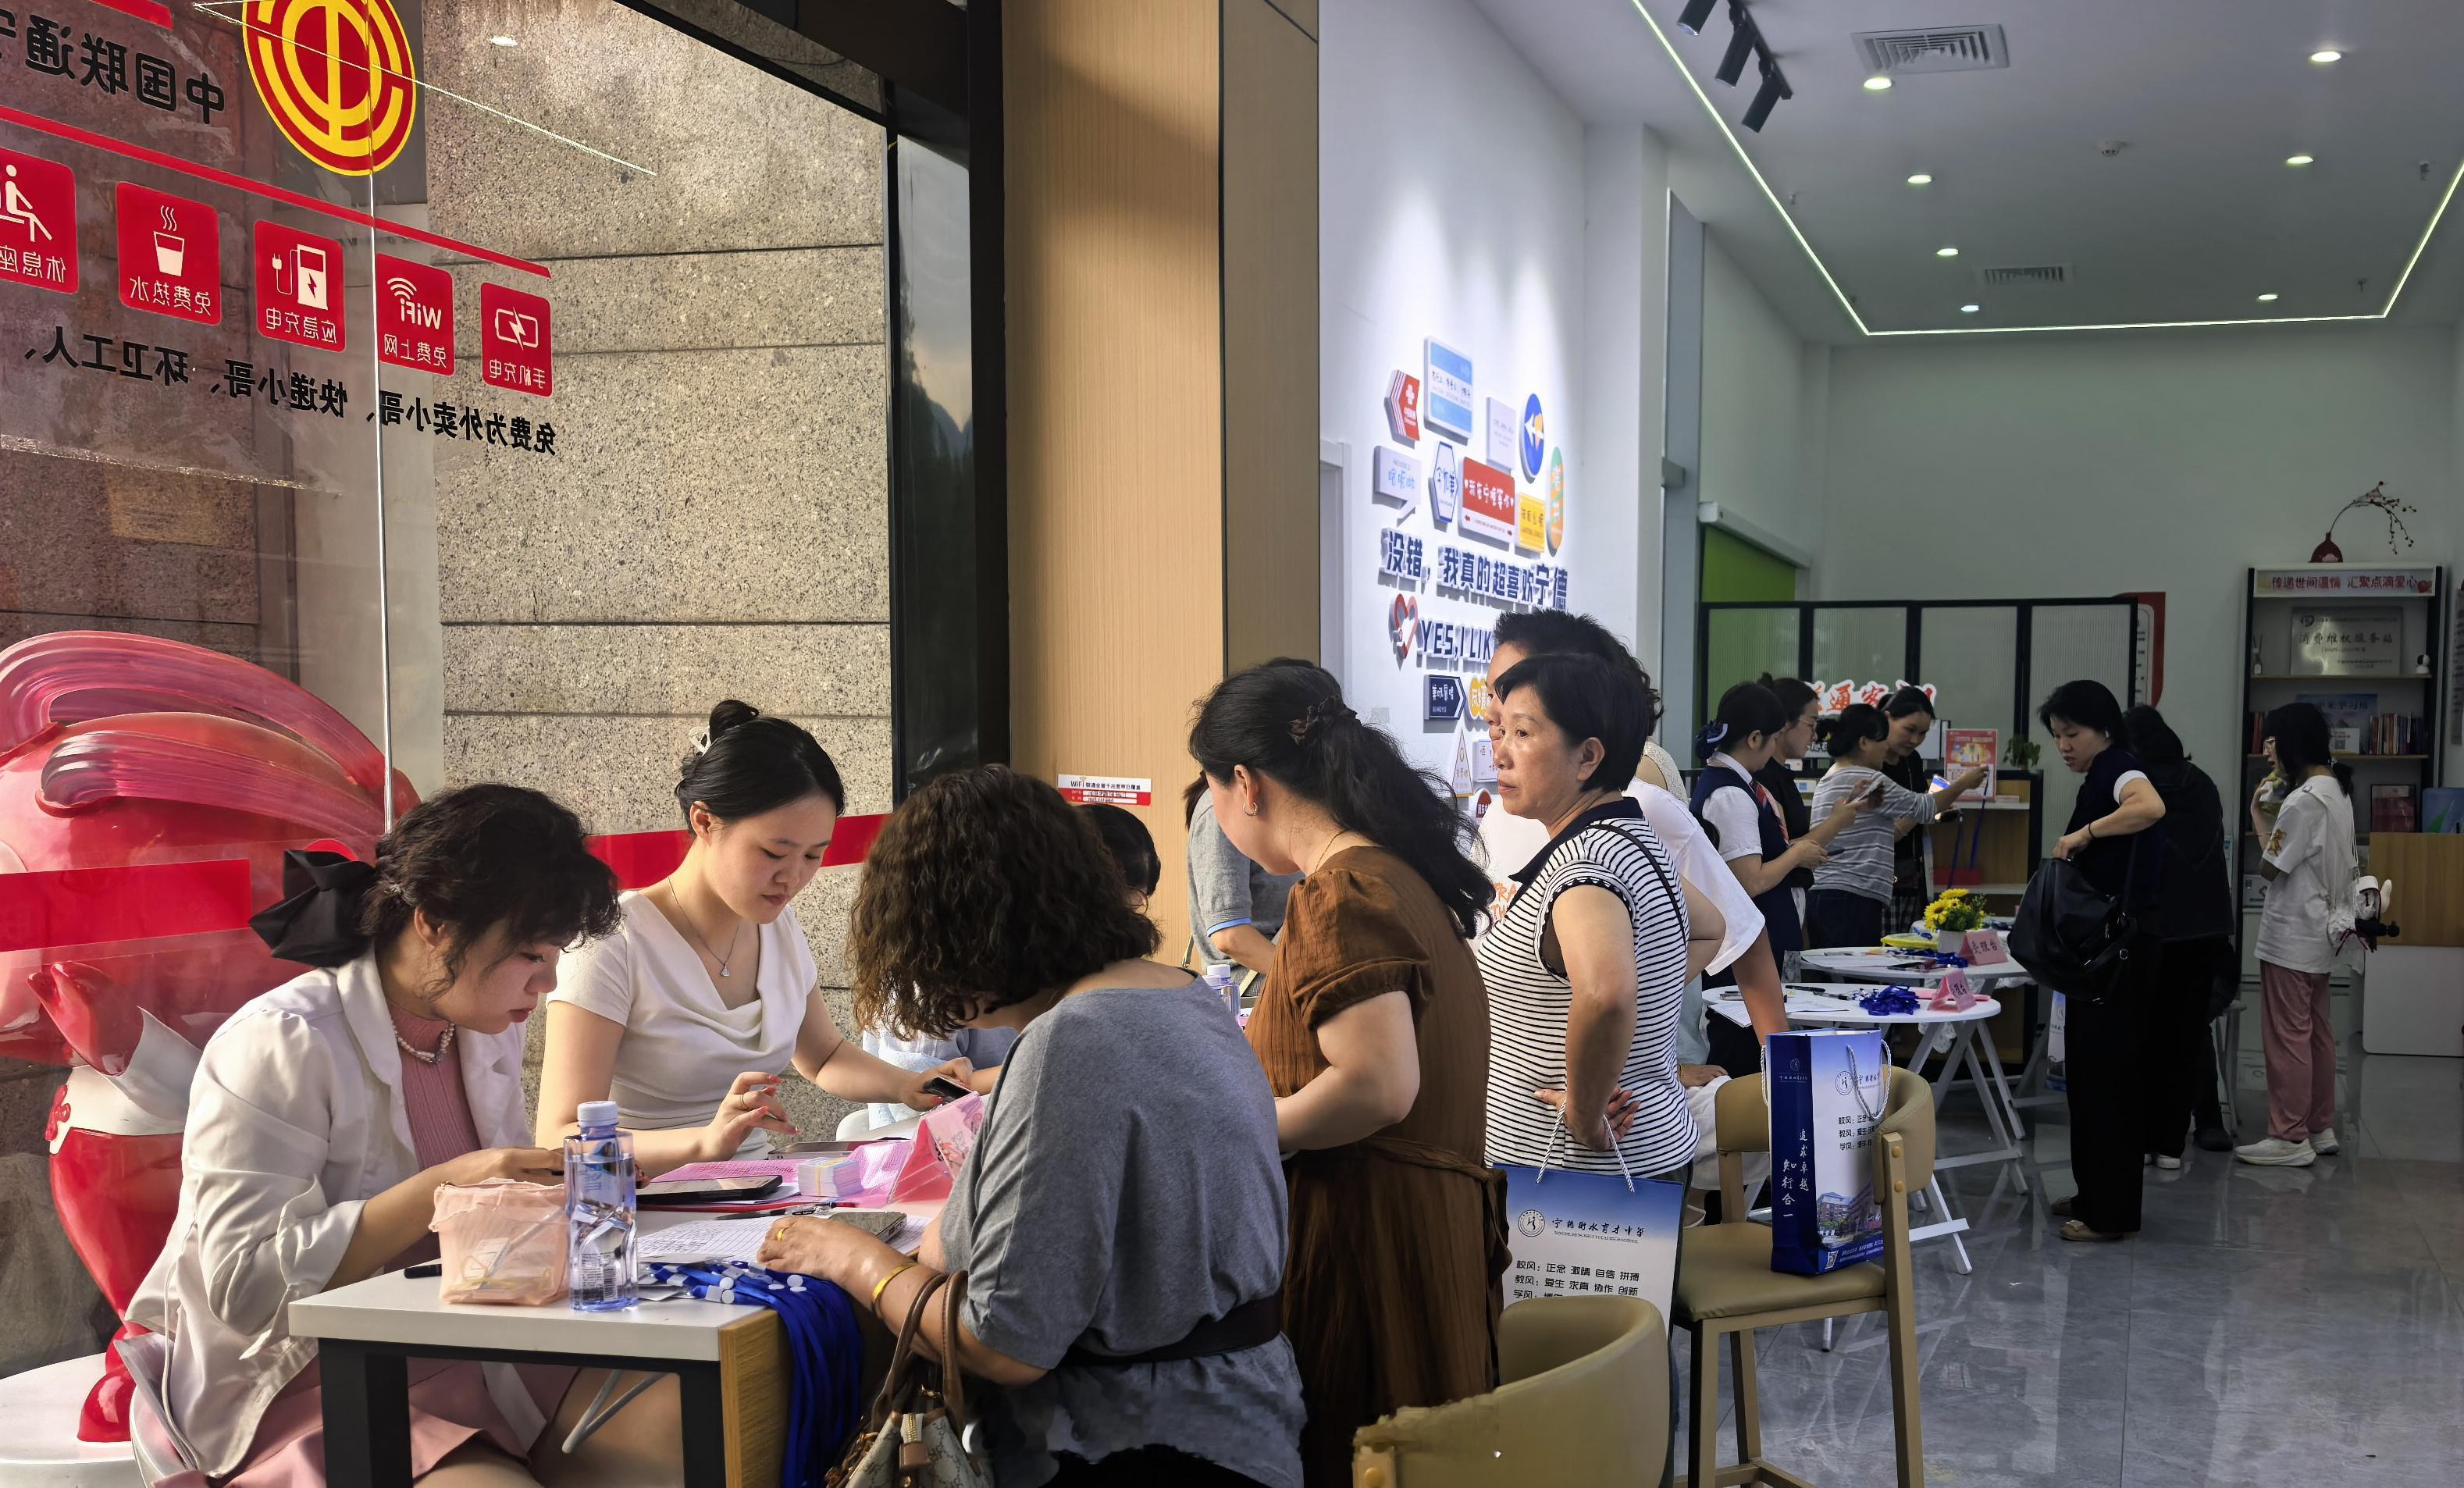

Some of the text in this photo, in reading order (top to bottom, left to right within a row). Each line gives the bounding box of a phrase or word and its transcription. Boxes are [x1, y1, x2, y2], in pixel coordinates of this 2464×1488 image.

[1469, 625, 1494, 661] LIK
[1782, 1159, 1796, 1217] 知行合一
[1595, 1269, 1615, 1279] 自信
[1618, 1286, 1639, 1297] 创新
